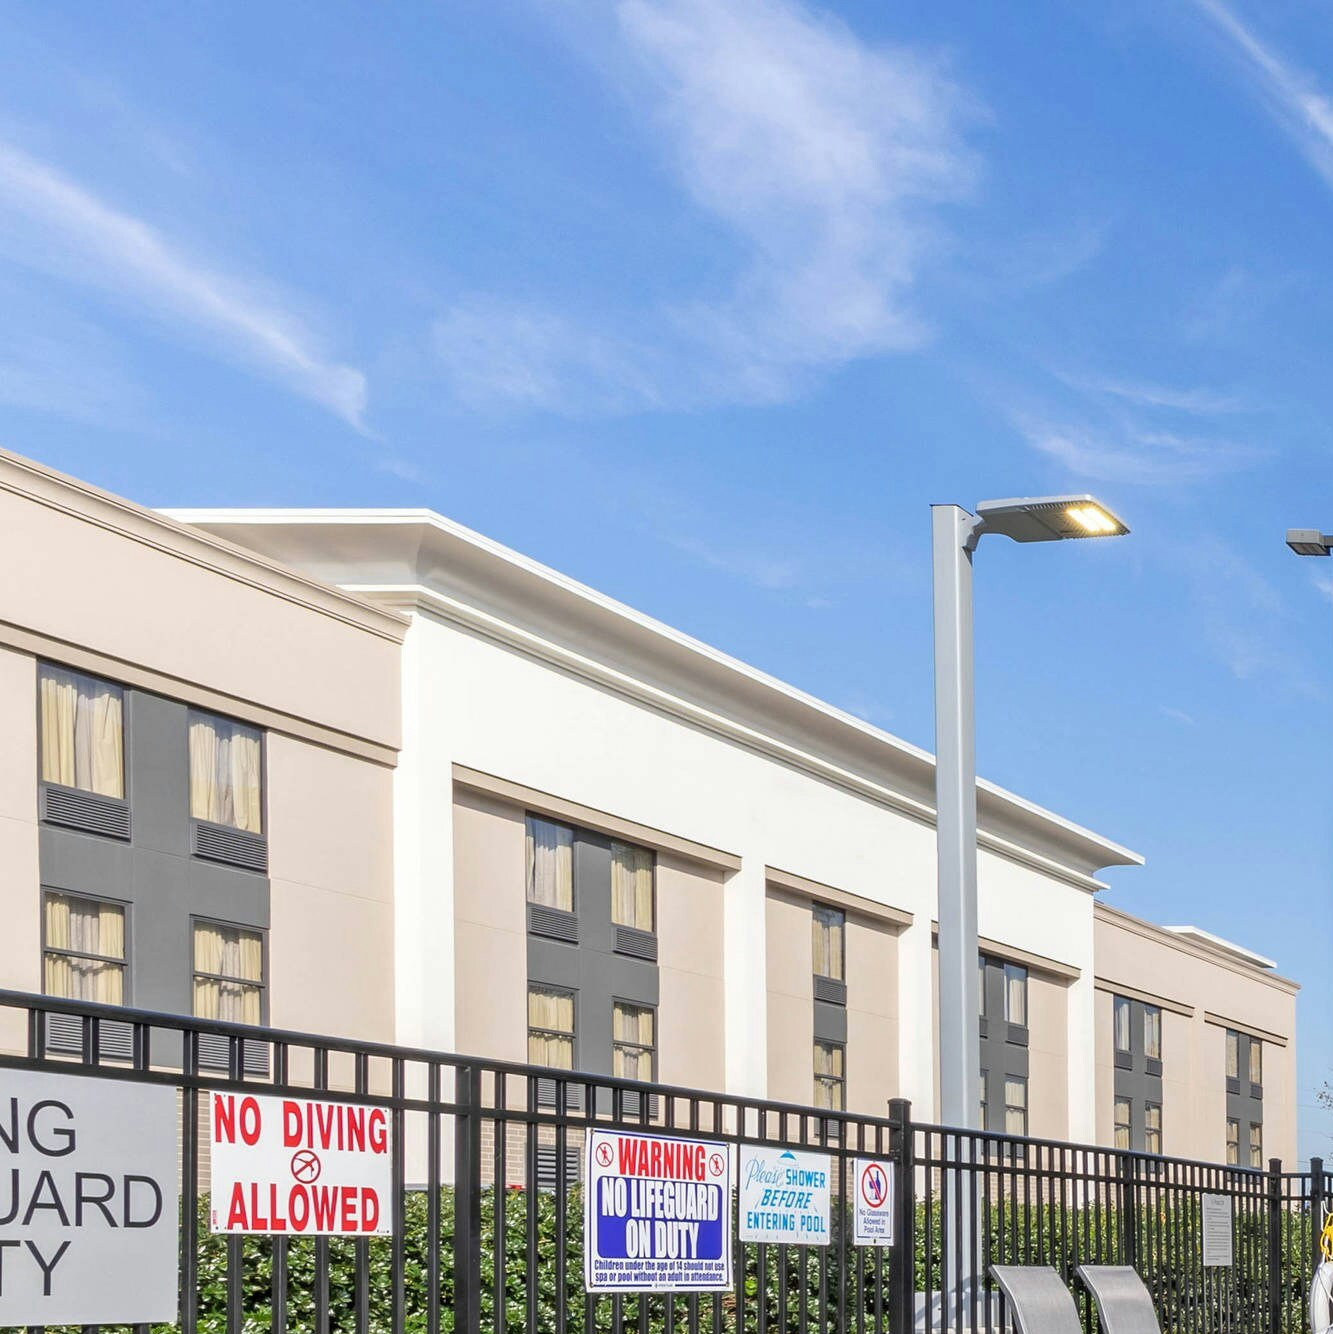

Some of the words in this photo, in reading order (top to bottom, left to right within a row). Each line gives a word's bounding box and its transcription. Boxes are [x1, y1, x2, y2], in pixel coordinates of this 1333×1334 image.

[214, 1094, 262, 1146] NO
[283, 1100, 388, 1154] DIVING
[618, 1138, 705, 1181] WARNING
[745, 1157, 785, 1190] Please
[786, 1169, 825, 1188] SHOWER
[227, 1181, 379, 1232] ALLOWED
[602, 1177, 627, 1217] NO
[631, 1180, 718, 1221] LIFEGUARD
[761, 1189, 812, 1209] BEFORE
[626, 1219, 650, 1258] ON
[655, 1221, 699, 1259] DUTY
[747, 1211, 794, 1231] ENTERING
[801, 1215, 825, 1233] POOL
[595, 1260, 623, 1270] Children
[625, 1262, 644, 1270] under
[646, 1261, 655, 1270] the
[657, 1262, 667, 1272] age
[669, 1262, 675, 1271] of
[677, 1262, 682, 1271] 14
[684, 1262, 703, 1271] should
[705, 1262, 713, 1271] not
[715, 1263, 724, 1271] use
[595, 1273, 607, 1282] spa
[609, 1273, 616, 1281] or
[618, 1272, 632, 1282] pool
[634, 1272, 657, 1281] without
[659, 1273, 666, 1281] an
[668, 1272, 682, 1281] adult
[691, 1272, 723, 1281] attendance.
